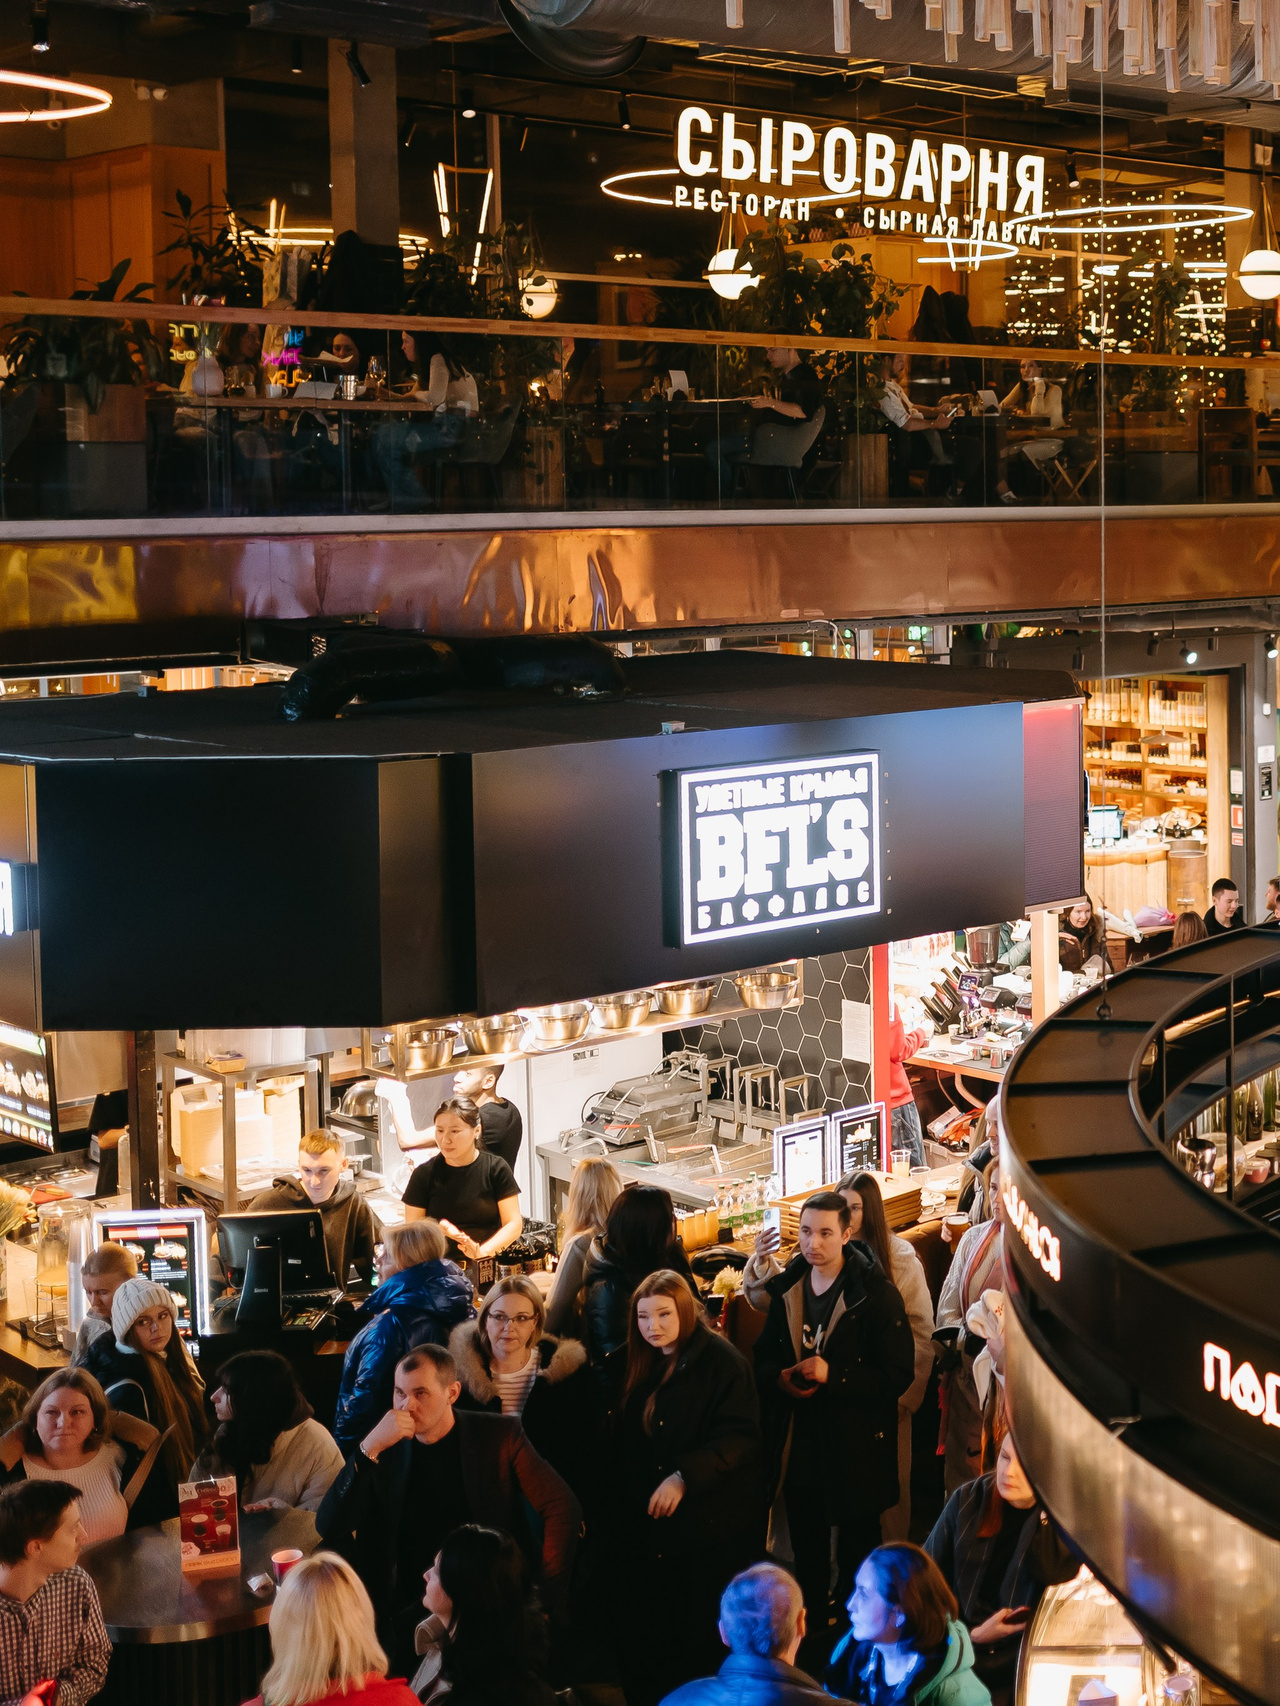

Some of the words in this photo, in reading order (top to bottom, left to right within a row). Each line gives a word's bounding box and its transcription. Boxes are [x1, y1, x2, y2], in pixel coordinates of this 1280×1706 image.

[678, 107, 1045, 215] СЫРОВАРНЯ
[675, 185, 810, 221] РЕСТОРАН
[863, 206, 959, 238] СЫРНАЯ
[970, 219, 1040, 246] ЛАВКА
[696, 798, 870, 903] BFL'S
[697, 881, 870, 929] БАФФАЛОС
